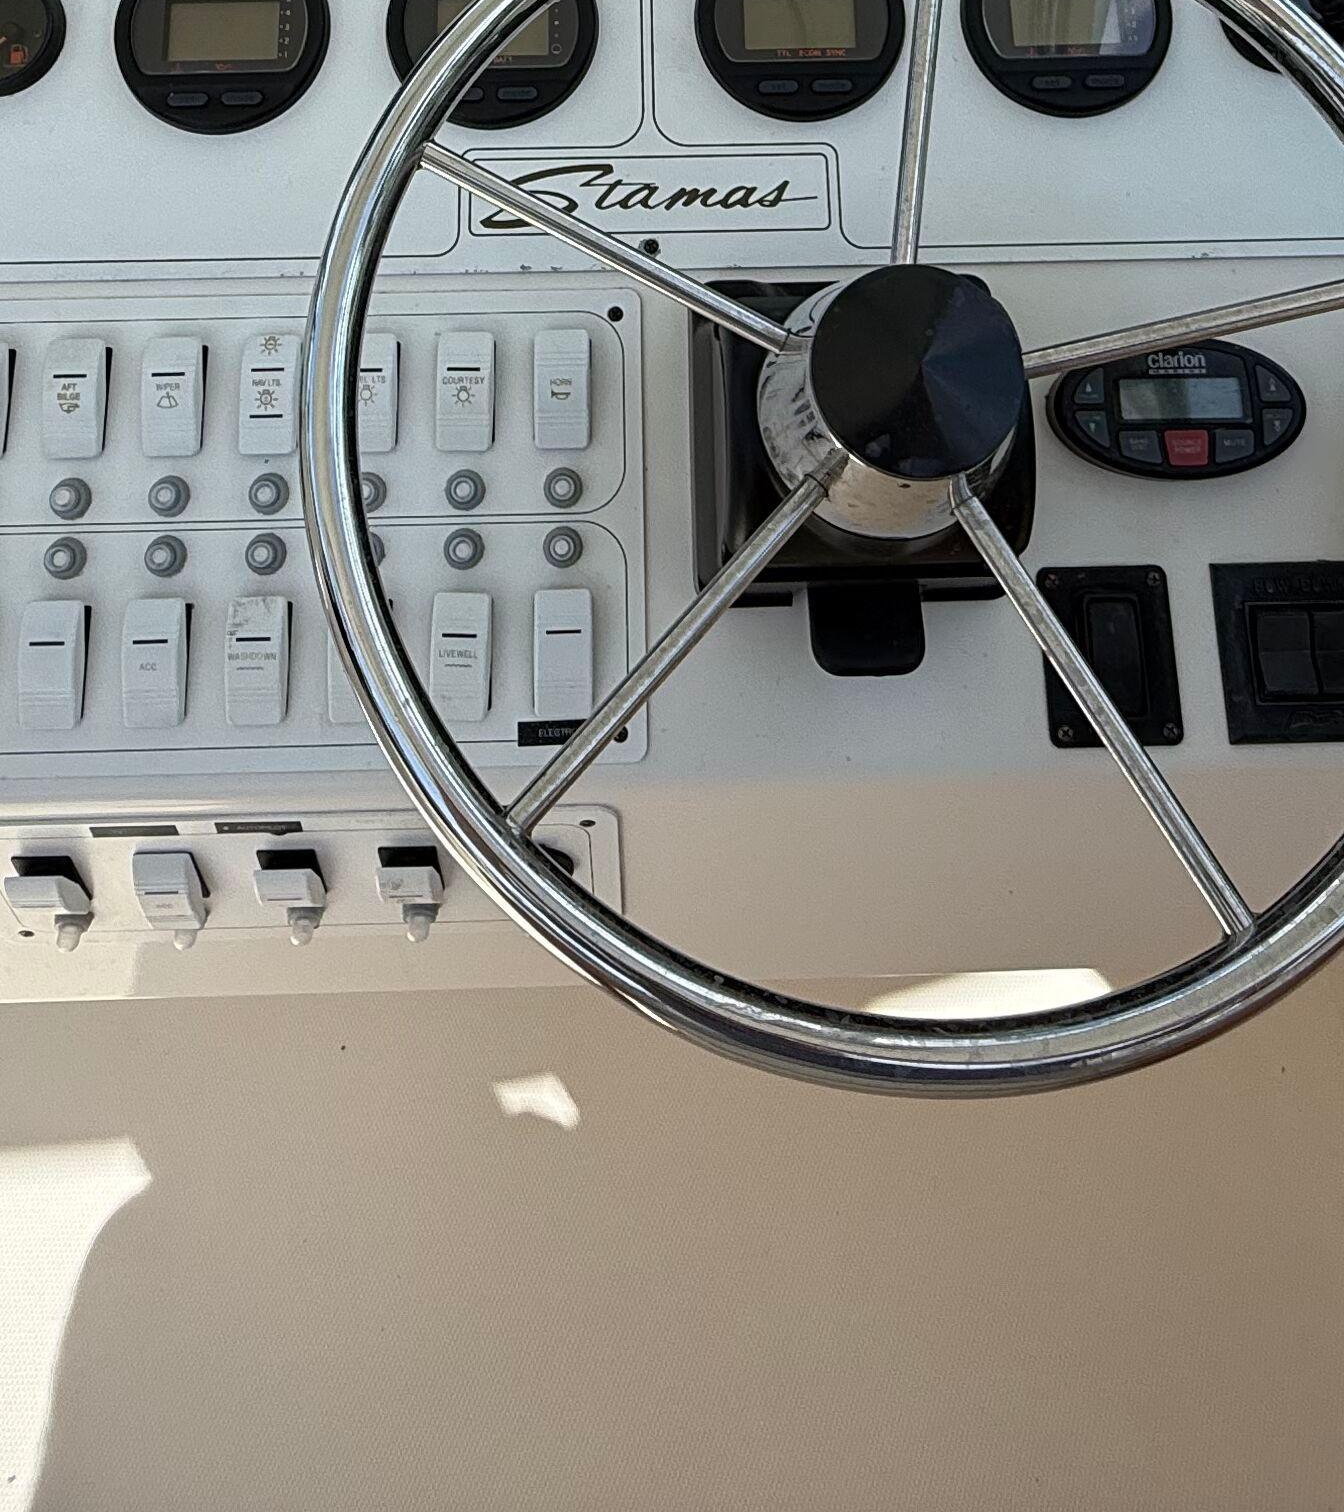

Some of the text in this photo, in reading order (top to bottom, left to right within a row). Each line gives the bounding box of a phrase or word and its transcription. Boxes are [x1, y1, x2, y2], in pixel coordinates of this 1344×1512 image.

[480, 163, 819, 230] Stamas
[1147, 351, 1206, 368] clarion
[442, 375, 485, 385] COURTESY
[549, 378, 573, 387] HORN
[61, 383, 78, 392] AFT
[56, 392, 81, 402] BILGE
[1223, 439, 1246, 447] MUTE
[227, 651, 278, 662] WASHDOWN
[437, 649, 479, 660] LIVEWELL
[138, 661, 158, 672] ACC
